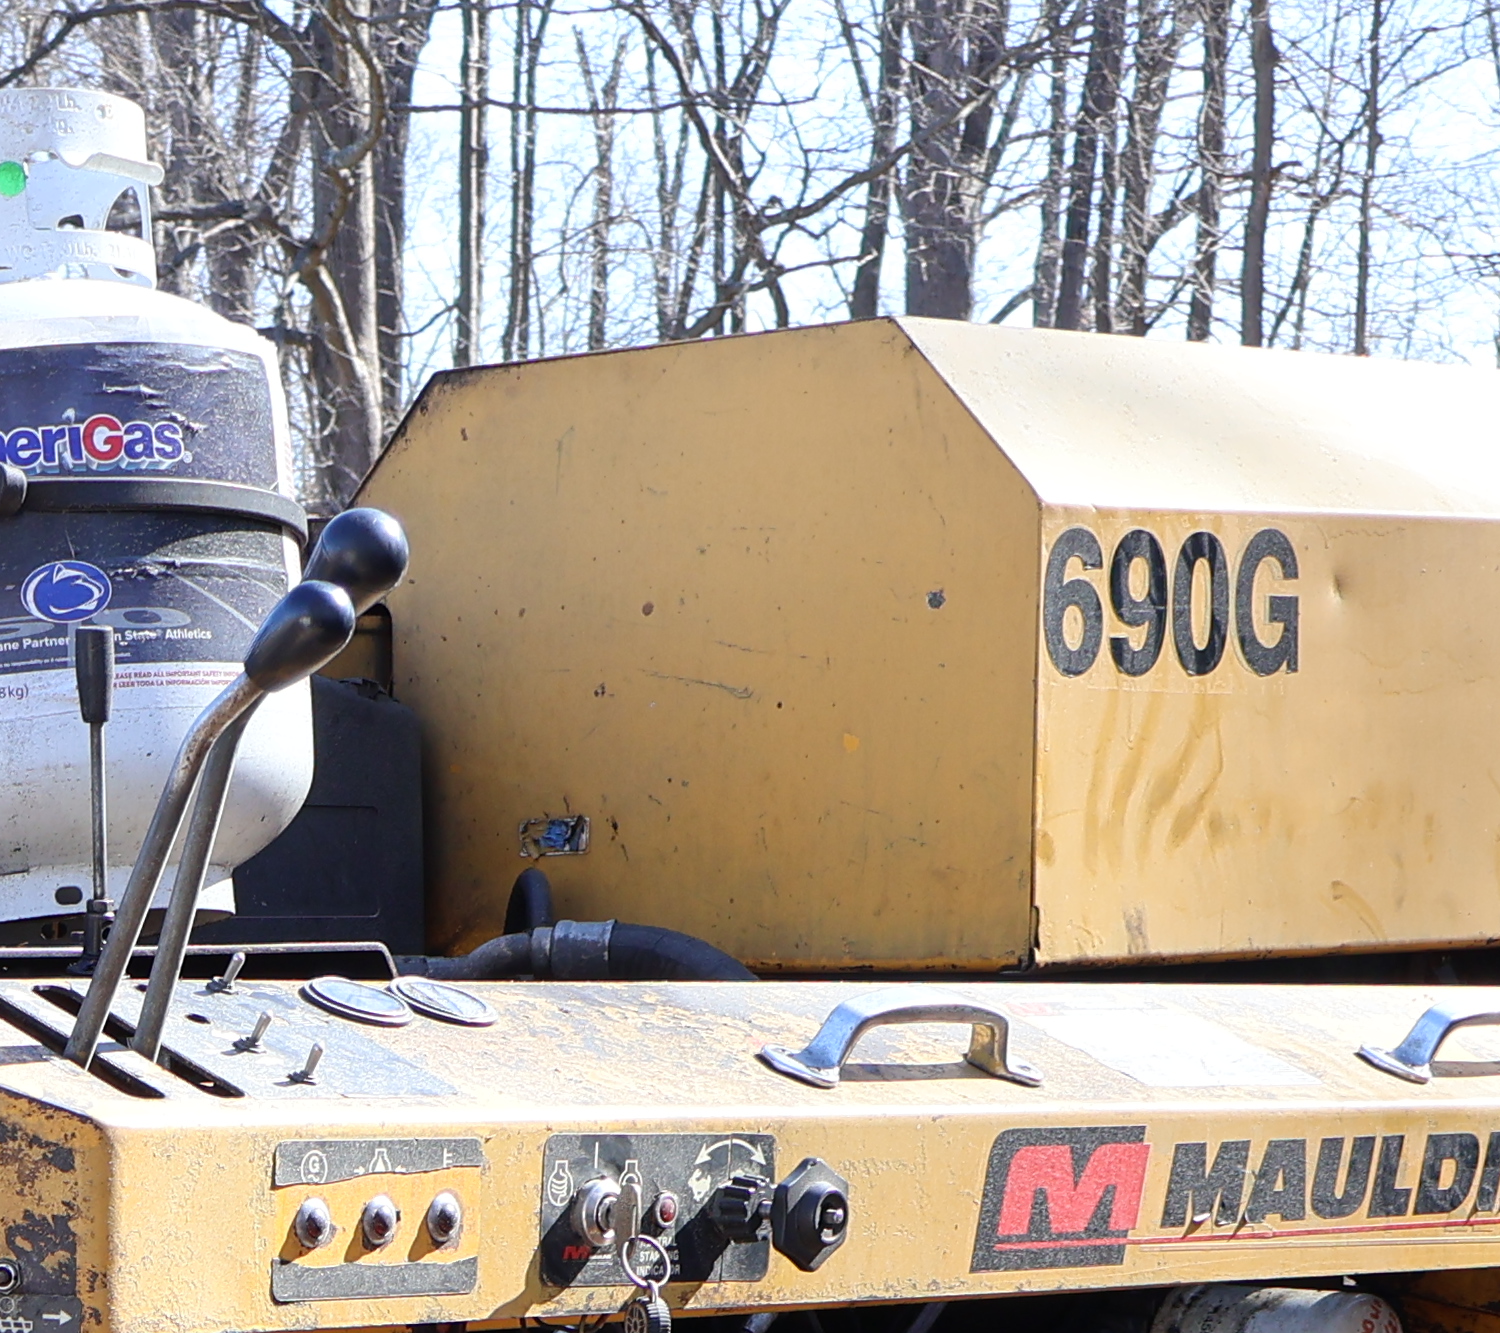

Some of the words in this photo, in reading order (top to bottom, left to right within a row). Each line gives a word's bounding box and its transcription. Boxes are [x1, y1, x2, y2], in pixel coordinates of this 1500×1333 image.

[1043, 526, 1299, 678] 690G
[22, 636, 71, 650] Partner
[165, 627, 212, 641] Athletics
[114, 671, 132, 680] EASE
[134, 670, 152, 678] READ
[153, 670, 165, 678] ALL
[636, 1263, 680, 1276] INDICAOR
